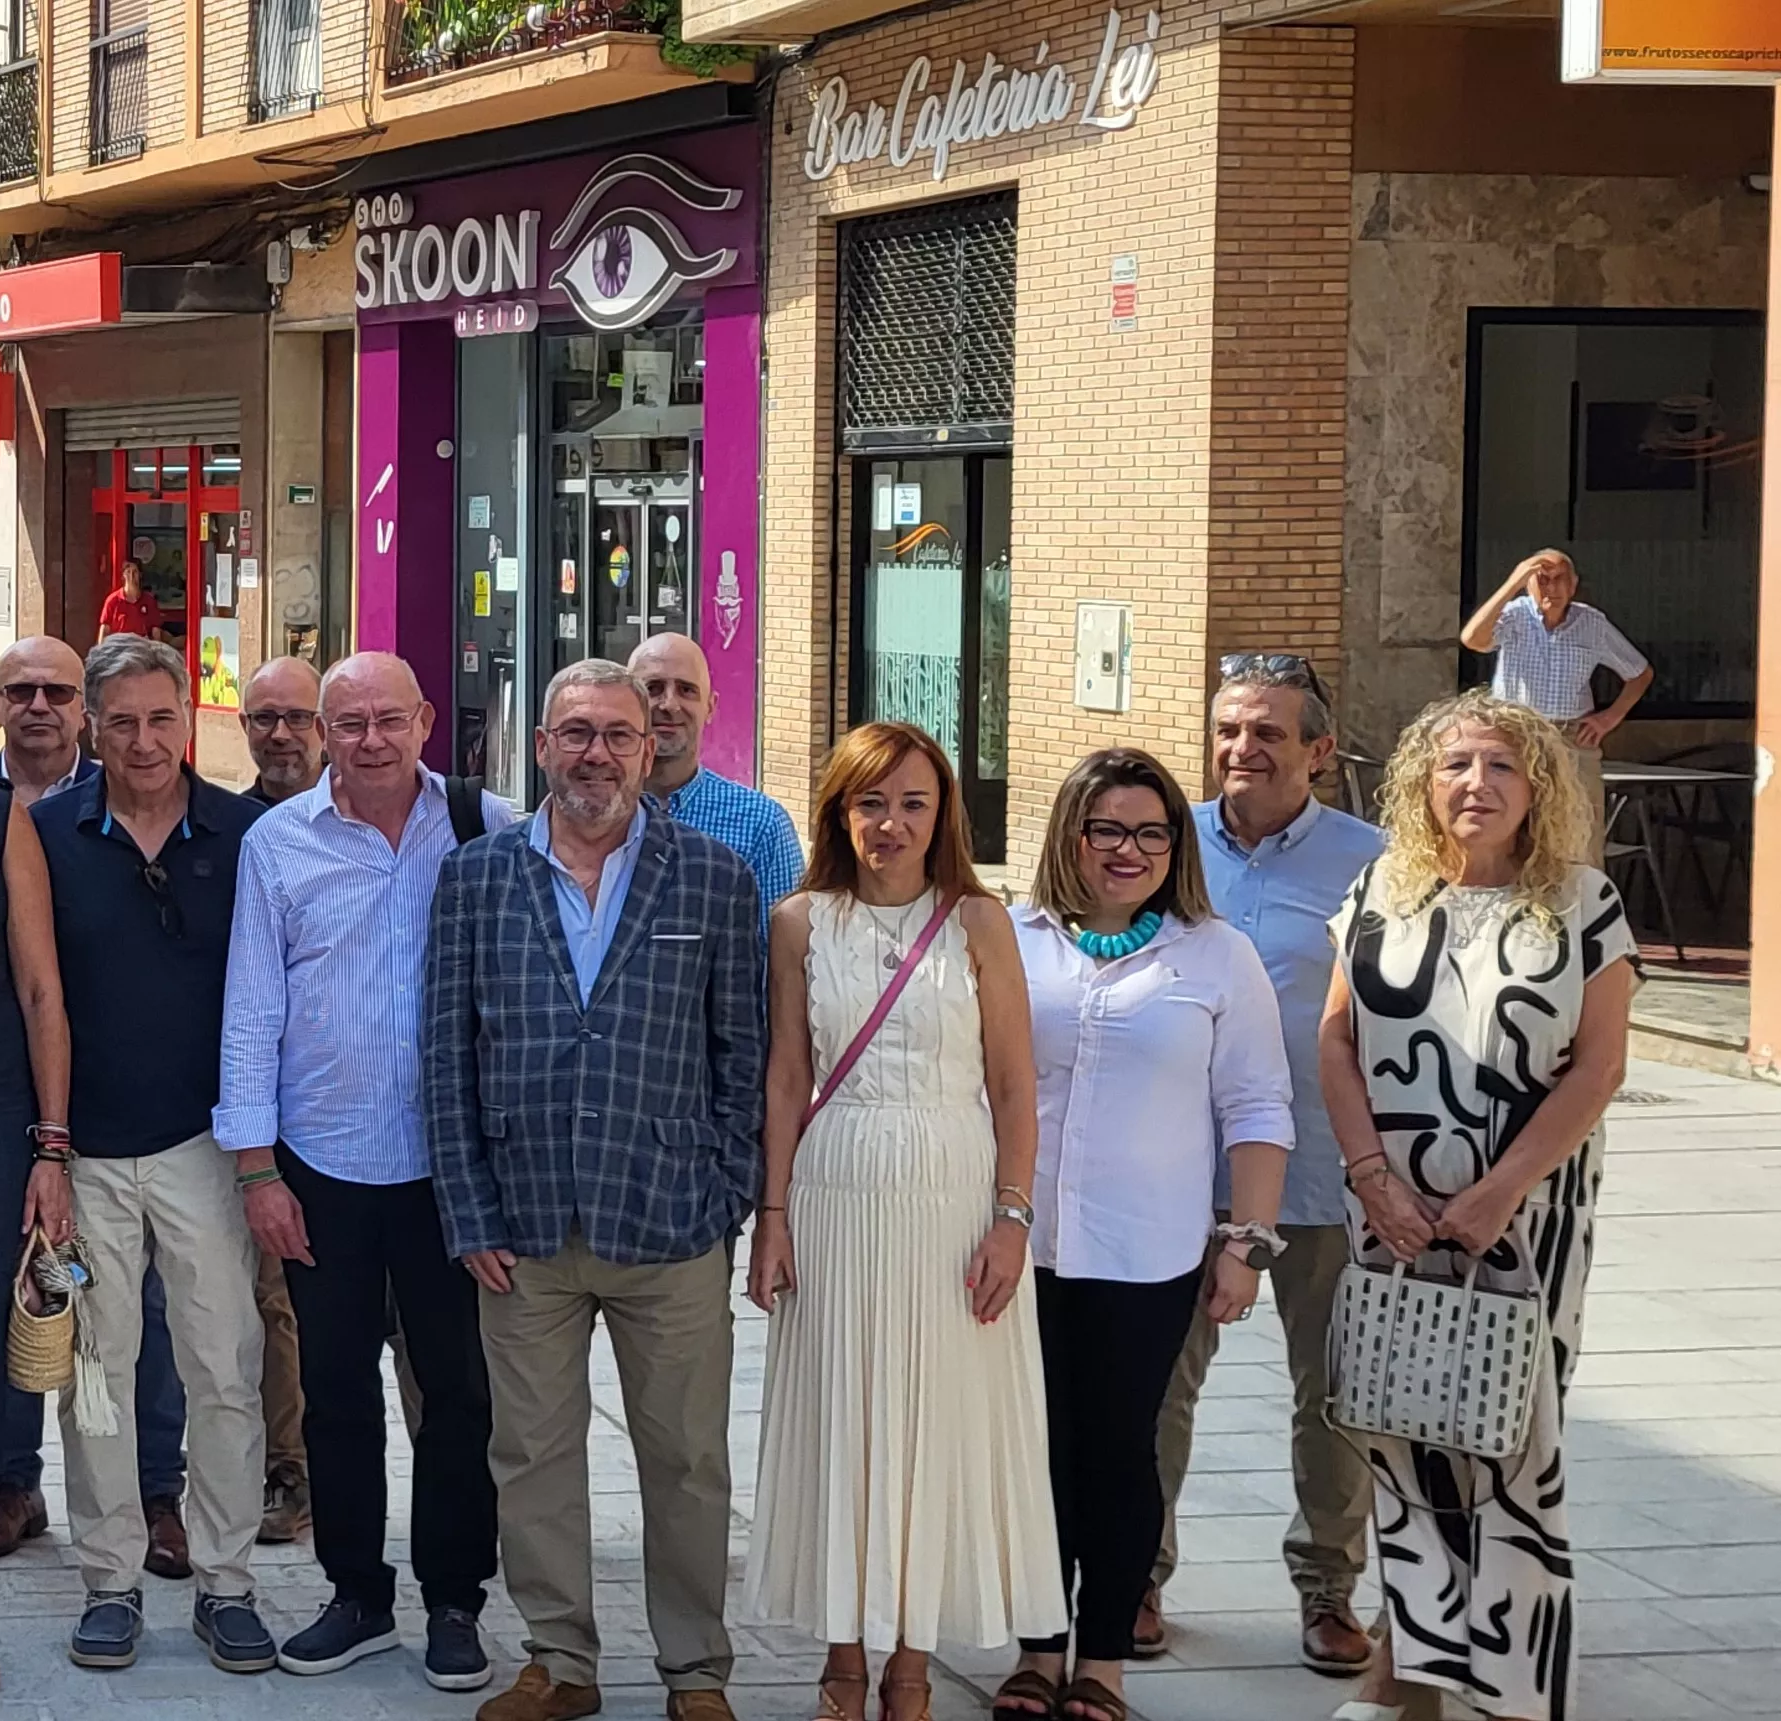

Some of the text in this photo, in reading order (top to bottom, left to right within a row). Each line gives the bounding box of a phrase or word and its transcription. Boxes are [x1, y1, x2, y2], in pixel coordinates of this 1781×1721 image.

[804, 7, 1162, 183] Bar Cafetería Lei
[355, 209, 536, 309] SKOON
[456, 302, 529, 334] HEID
